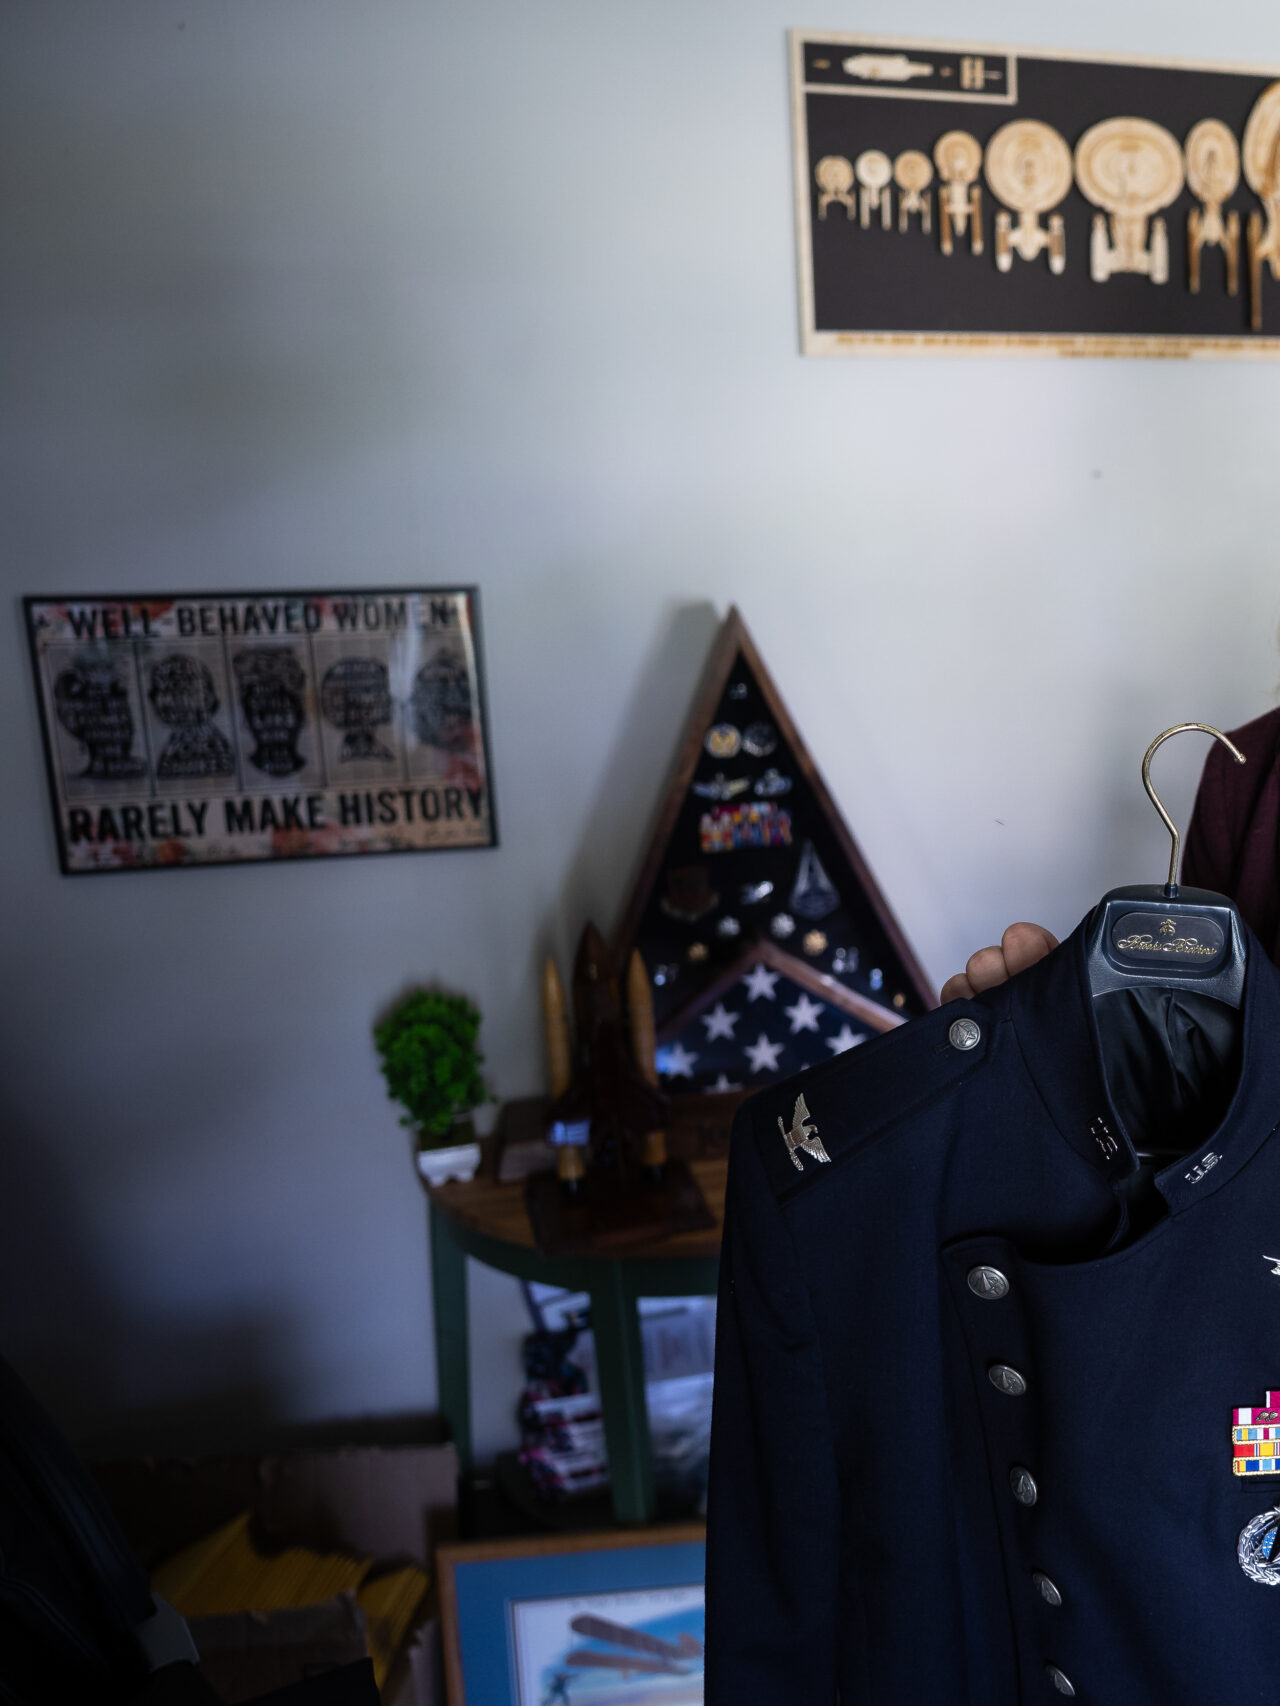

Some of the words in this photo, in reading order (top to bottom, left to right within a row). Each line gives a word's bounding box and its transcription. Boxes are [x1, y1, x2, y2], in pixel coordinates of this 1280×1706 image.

[335, 600, 449, 632] WOMEN
[68, 799, 210, 844] RARELY
[225, 794, 326, 834] MAKE
[340, 785, 486, 826] HISTORY
[1117, 934, 1163, 951] Brooks
[1162, 937, 1217, 955] Brothers
